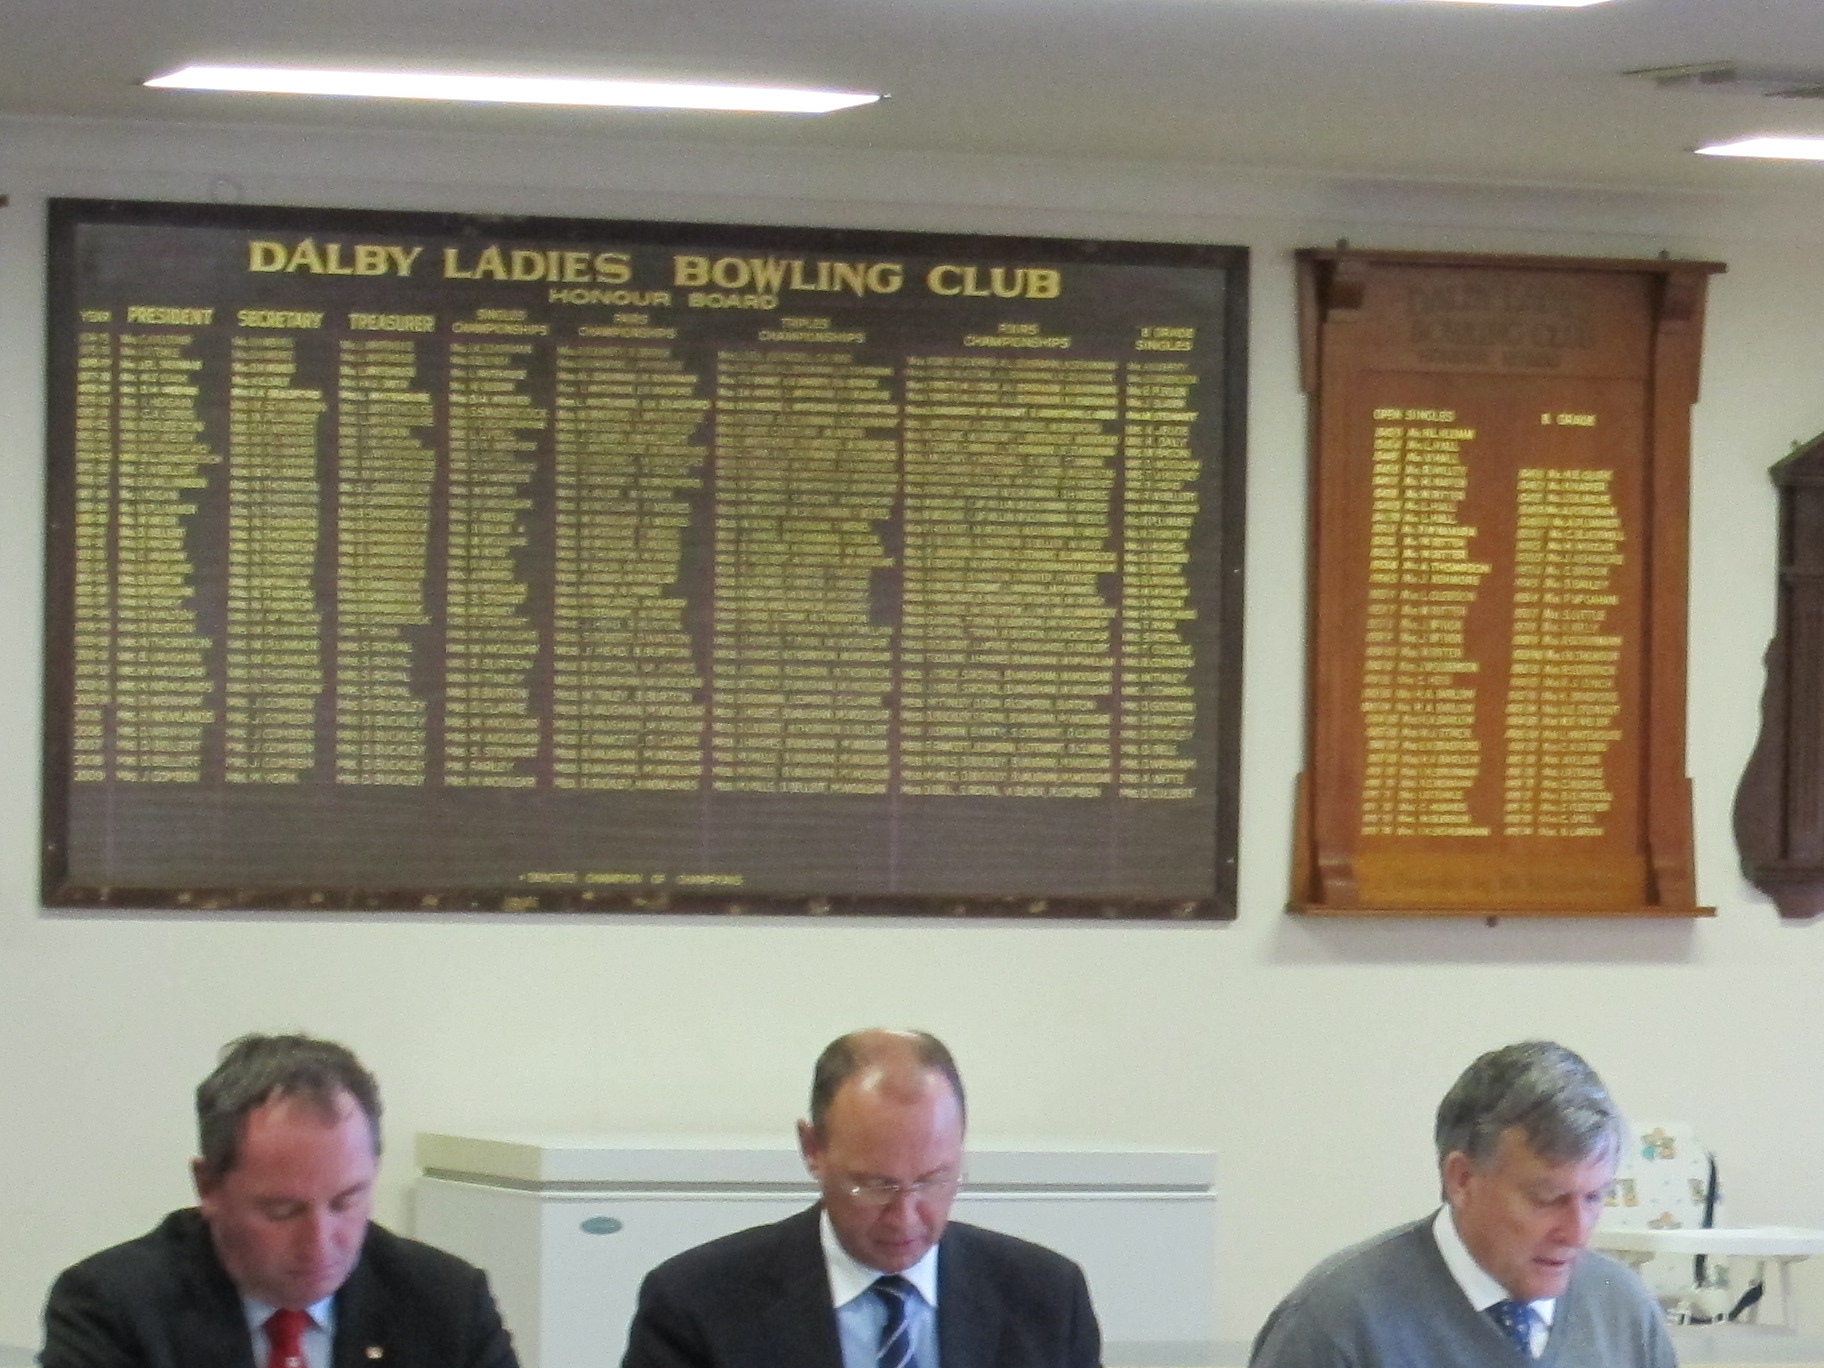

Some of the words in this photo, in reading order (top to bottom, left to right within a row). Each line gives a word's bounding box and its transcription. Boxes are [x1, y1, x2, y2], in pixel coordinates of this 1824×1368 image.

[249, 238, 422, 278] DALBY
[443, 245, 631, 284] LADIES
[674, 255, 903, 297] BOWLING
[926, 265, 1062, 299] CLUB
[549, 288, 672, 306] HONOUR
[688, 293, 779, 309] BOARD
[127, 305, 215, 325] PRESIDENT
[236, 310, 325, 329] SECRETARY
[348, 313, 436, 332] TREASURER
